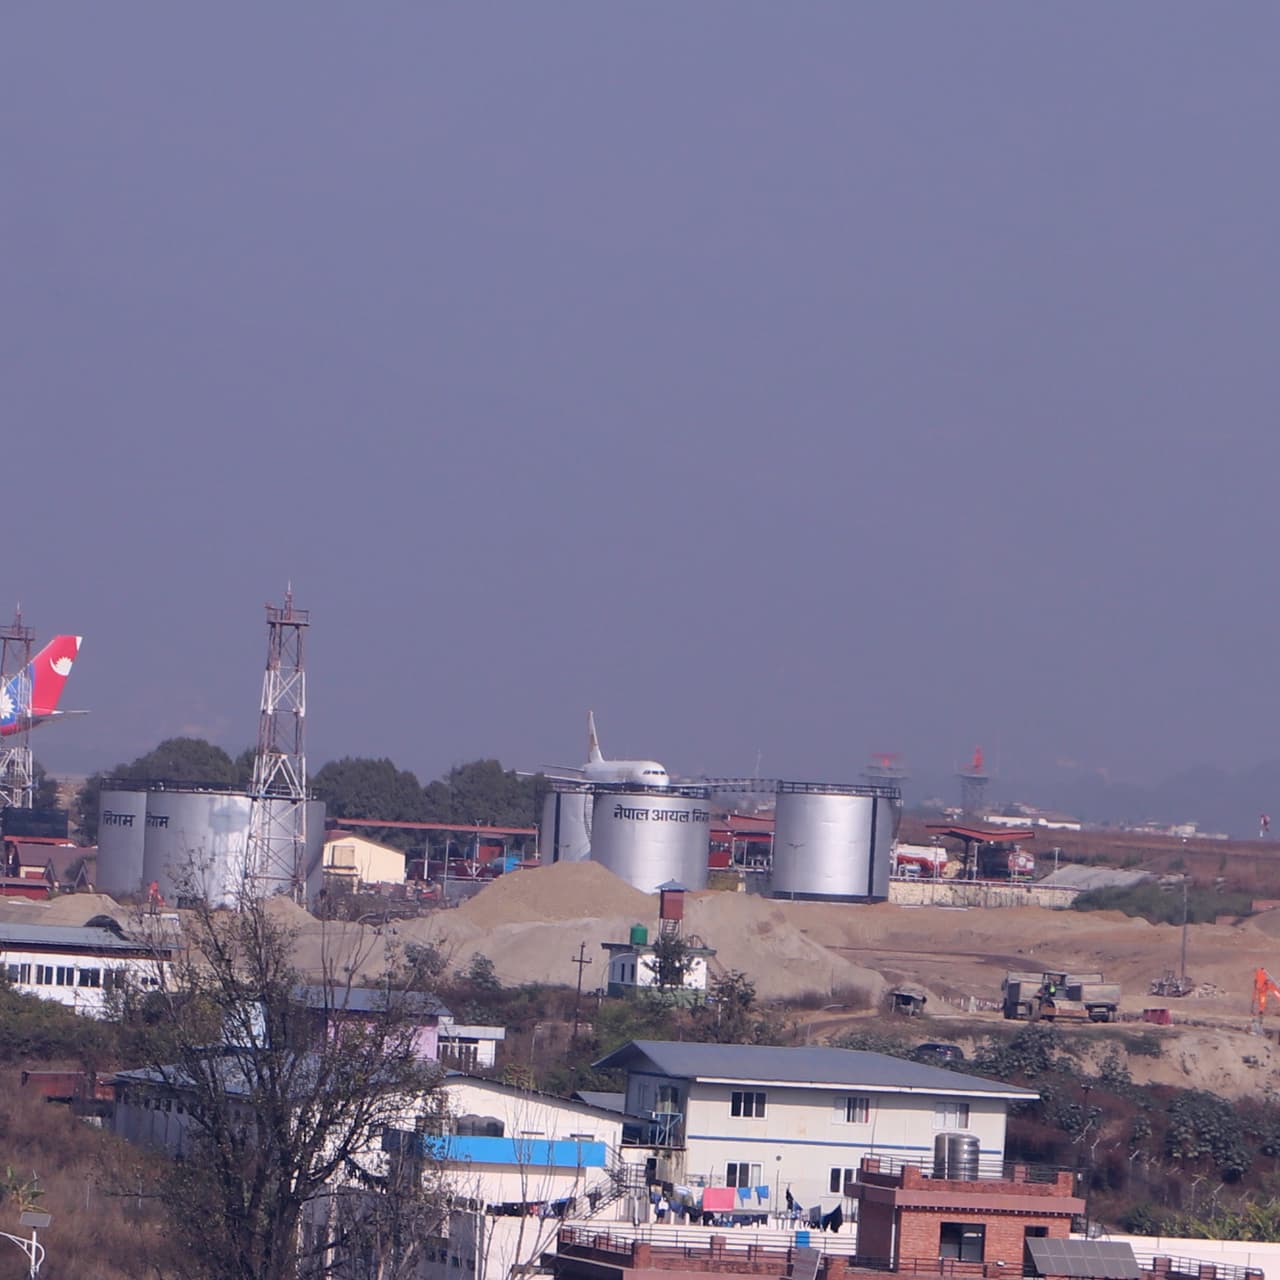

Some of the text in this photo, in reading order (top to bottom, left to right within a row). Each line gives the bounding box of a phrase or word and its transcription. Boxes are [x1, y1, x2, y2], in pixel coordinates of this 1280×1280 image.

[103, 810, 136, 827] निगम
[613, 803, 649, 821] नेपाल
[651, 809, 690, 823] आयल
